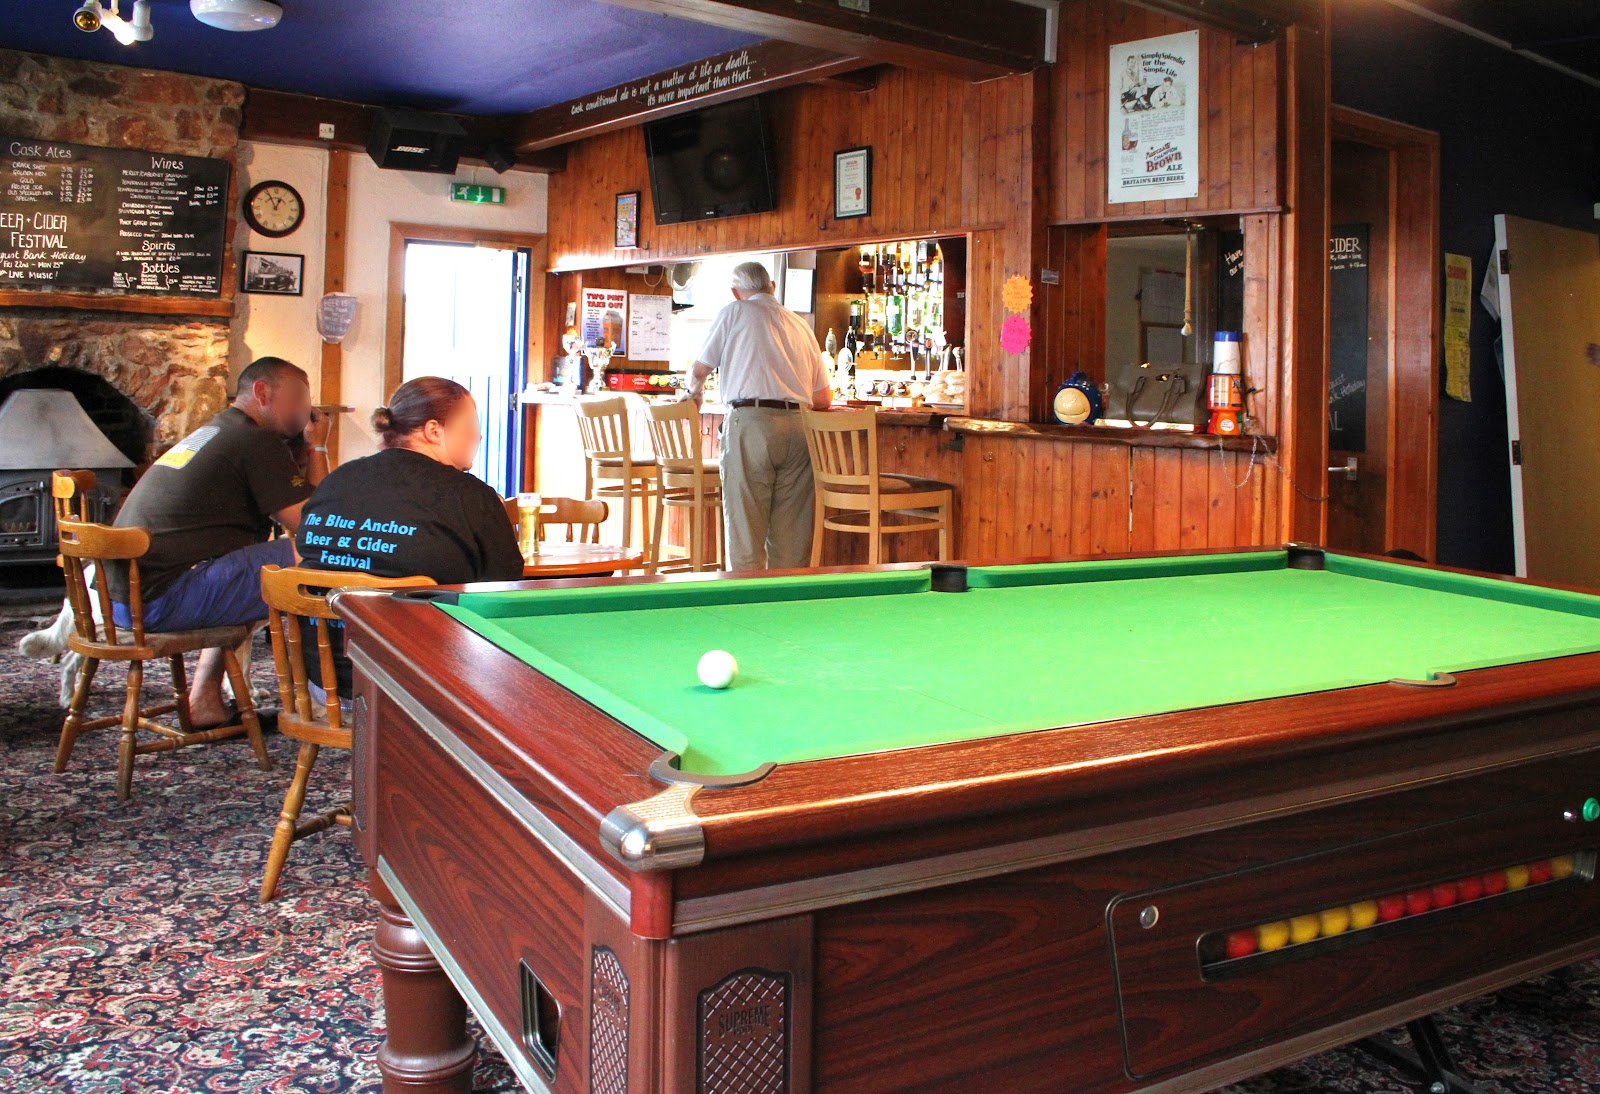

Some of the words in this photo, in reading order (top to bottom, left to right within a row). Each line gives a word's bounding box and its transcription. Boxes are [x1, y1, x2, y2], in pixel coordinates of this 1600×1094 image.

[1161, 53, 1186, 66] Splendid
[632, 87, 637, 97] is
[640, 79, 651, 95] not
[654, 82, 659, 91] a
[662, 71, 686, 88] matter
[689, 65, 697, 80] of
[700, 60, 713, 78] life
[714, 62, 723, 74] or
[1165, 68, 1178, 77] Life
[658, 91, 675, 103] more
[677, 77, 711, 100] important
[713, 75, 730, 89] than
[10, 141, 42, 157] Cask
[45, 146, 72, 158] Ales
[151, 156, 184, 170] Wines
[1145, 151, 1183, 173] Brown
[1166, 163, 1183, 171] ALE
[1122, 178, 1151, 186] BRITAIN'S
[33, 211, 68, 232] CIDER
[11, 231, 68, 249] FESTIVAL
[142, 240, 176, 252] Spirits
[23, 249, 47, 260] Bank
[50, 251, 87, 264] Holiday
[8, 270, 24, 278] LIVE
[141, 262, 180, 274] Bottles
[305, 513, 322, 526] The
[325, 514, 356, 530] Blue
[359, 518, 417, 536] Anchor
[305, 531, 333, 546] Beer
[337, 536, 352, 548] &
[357, 537, 398, 554] Cider
[320, 550, 371, 570] Festival
[718, 1005, 771, 1038] SUPREME
